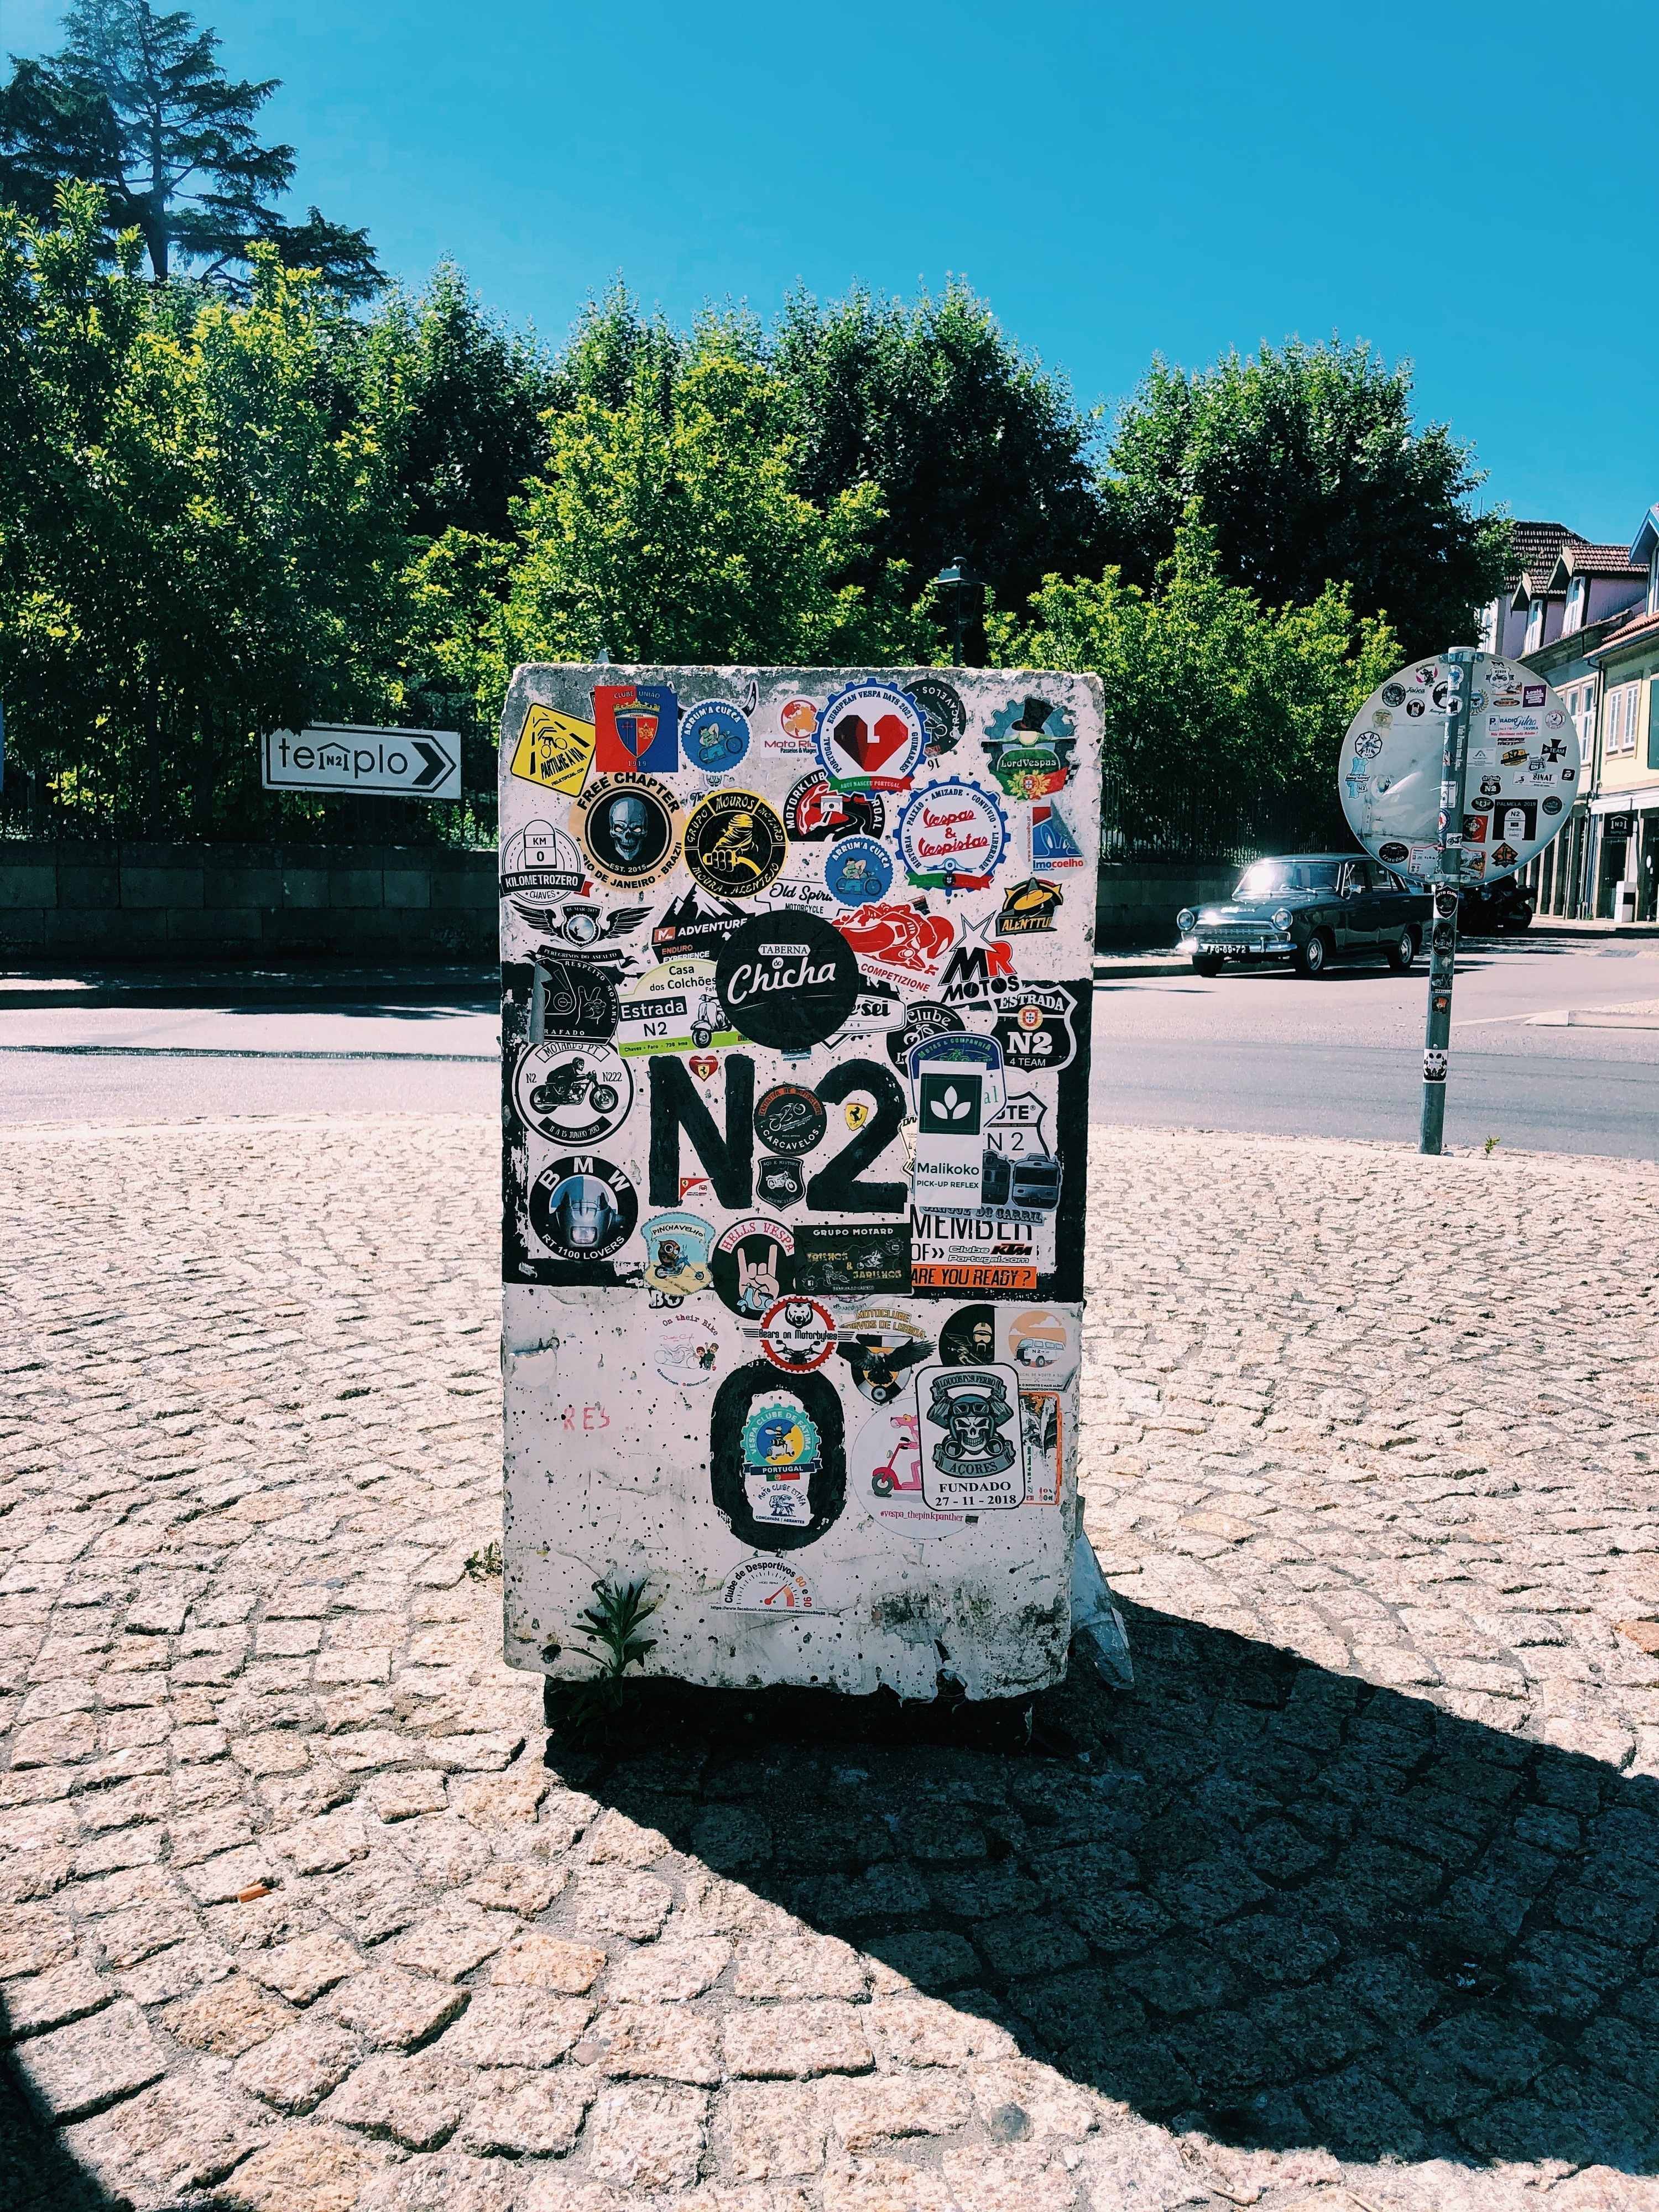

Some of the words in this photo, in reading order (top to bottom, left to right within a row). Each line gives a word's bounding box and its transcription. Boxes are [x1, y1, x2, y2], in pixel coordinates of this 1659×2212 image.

[716, 706, 741, 723] CUECA
[827, 693, 857, 724] EUROPEAN
[883, 693, 900, 705] DAYS
[899, 703, 914, 719] 2021
[540, 753, 570, 780] PARTILHE
[572, 747, 587, 760] VIA
[823, 737, 842, 774] PORTUGAL
[1001, 759, 1057, 768] LordVespas
[577, 776, 611, 810] FREE
[614, 772, 680, 813] CHAPTER
[786, 771, 825, 828] MOTORKLUB
[716, 796, 755, 811] MOUROS
[906, 801, 924, 826] PAIXÃO
[931, 789, 963, 800] AMIZADE
[687, 809, 708, 842] GRUPO
[758, 808, 782, 841] MOTARD
[923, 807, 977, 828] Vespas
[945, 827, 957, 839] &
[918, 833, 990, 858] Vespistas
[978, 832, 999, 872] LIBERDADE
[536, 851, 544, 862] 0
[869, 844, 890, 868] CUECA
[1033, 858, 1084, 869] Imocoelho
[609, 863, 626, 873] EST.
[628, 864, 646, 873] 2015
[505, 874, 578, 888] KILOMETROZERO
[594, 869, 609, 883] DE
[611, 876, 655, 889] JANEIRO
[692, 866, 723, 892] MOURA
[731, 863, 779, 894] ALENTEJO
[529, 890, 556, 899] CHAVES
[769, 883, 796, 898] Old
[785, 902, 824, 914] MOTORCYCLE
[661, 945, 693, 954] ENDURO
[760, 946, 808, 954] TABERNA
[565, 961, 605, 981] RESPEITO
[669, 966, 695, 975] Casa
[861, 963, 931, 993] COMPETIZIONE
[650, 983, 665, 992] dos
[667, 977, 716, 989] Colchões
[727, 957, 836, 1004] Chicha
[942, 975, 1019, 1004] MOTOS
[606, 985, 617, 1024] MOTARD
[620, 999, 685, 1019] Estrada
[999, 994, 1065, 1011] ESTRADA
[907, 1010, 951, 1026] Clube
[644, 1022, 667, 1037] N2
[918, 1042, 941, 1058] MOTAS
[1006, 1032, 1052, 1055] N2
[1019, 1058, 1046, 1066] TEAM
[526, 1073, 536, 1083] N2
[602, 1072, 622, 1082] N222
[648, 1053, 907, 1213] N2
[763, 1129, 819, 1150] CARCAVELOS
[917, 1162, 979, 1175] Malikoko
[652, 1225, 703, 1237] PINCHAVELHO
[721, 1223, 756, 1251] HELLS
[764, 1223, 795, 1253] VESPA
[541, 1234, 557, 1248] RT
[558, 1246, 580, 1259] 1100
[583, 1236, 625, 1260] LOVERS
[949, 1245, 989, 1254] Clube
[991, 1243, 1033, 1255] KTM
[846, 1261, 853, 1270] &
[948, 1255, 1029, 1264] Portugal.com
[912, 1268, 935, 1284] ARE
[942, 1269, 969, 1285] YOU
[973, 1270, 1019, 1286] READY
[856, 1308, 911, 1323] MOTOCLUBE
[662, 1318, 673, 1327] On
[702, 1319, 718, 1336] Bike
[879, 1321, 890, 1329] DE
[893, 1322, 925, 1339] LISBOA
[759, 1329, 779, 1339] Bears
[795, 1329, 837, 1342] Motorbykes
[940, 1375, 963, 1387] LOUCOS
[748, 1427, 758, 1455] VESPA
[756, 1411, 782, 1425] CLUBE
[786, 1412, 797, 1421] DE
[950, 1461, 998, 1477] AÇORES
[758, 1487, 771, 1500] MOTO
[939, 1481, 1011, 1493] FUNDADO
[935, 1496, 950, 1506] 27
[988, 1494, 1016, 1505] 2018
[880, 1510, 964, 1522] #vespa_thepinkpanther
[724, 1580, 738, 1603] Clube
[735, 1570, 746, 1580] de
[745, 1562, 796, 1578] Desportivos
[795, 1575, 807, 1588] 80
[804, 1597, 812, 1608] 90
